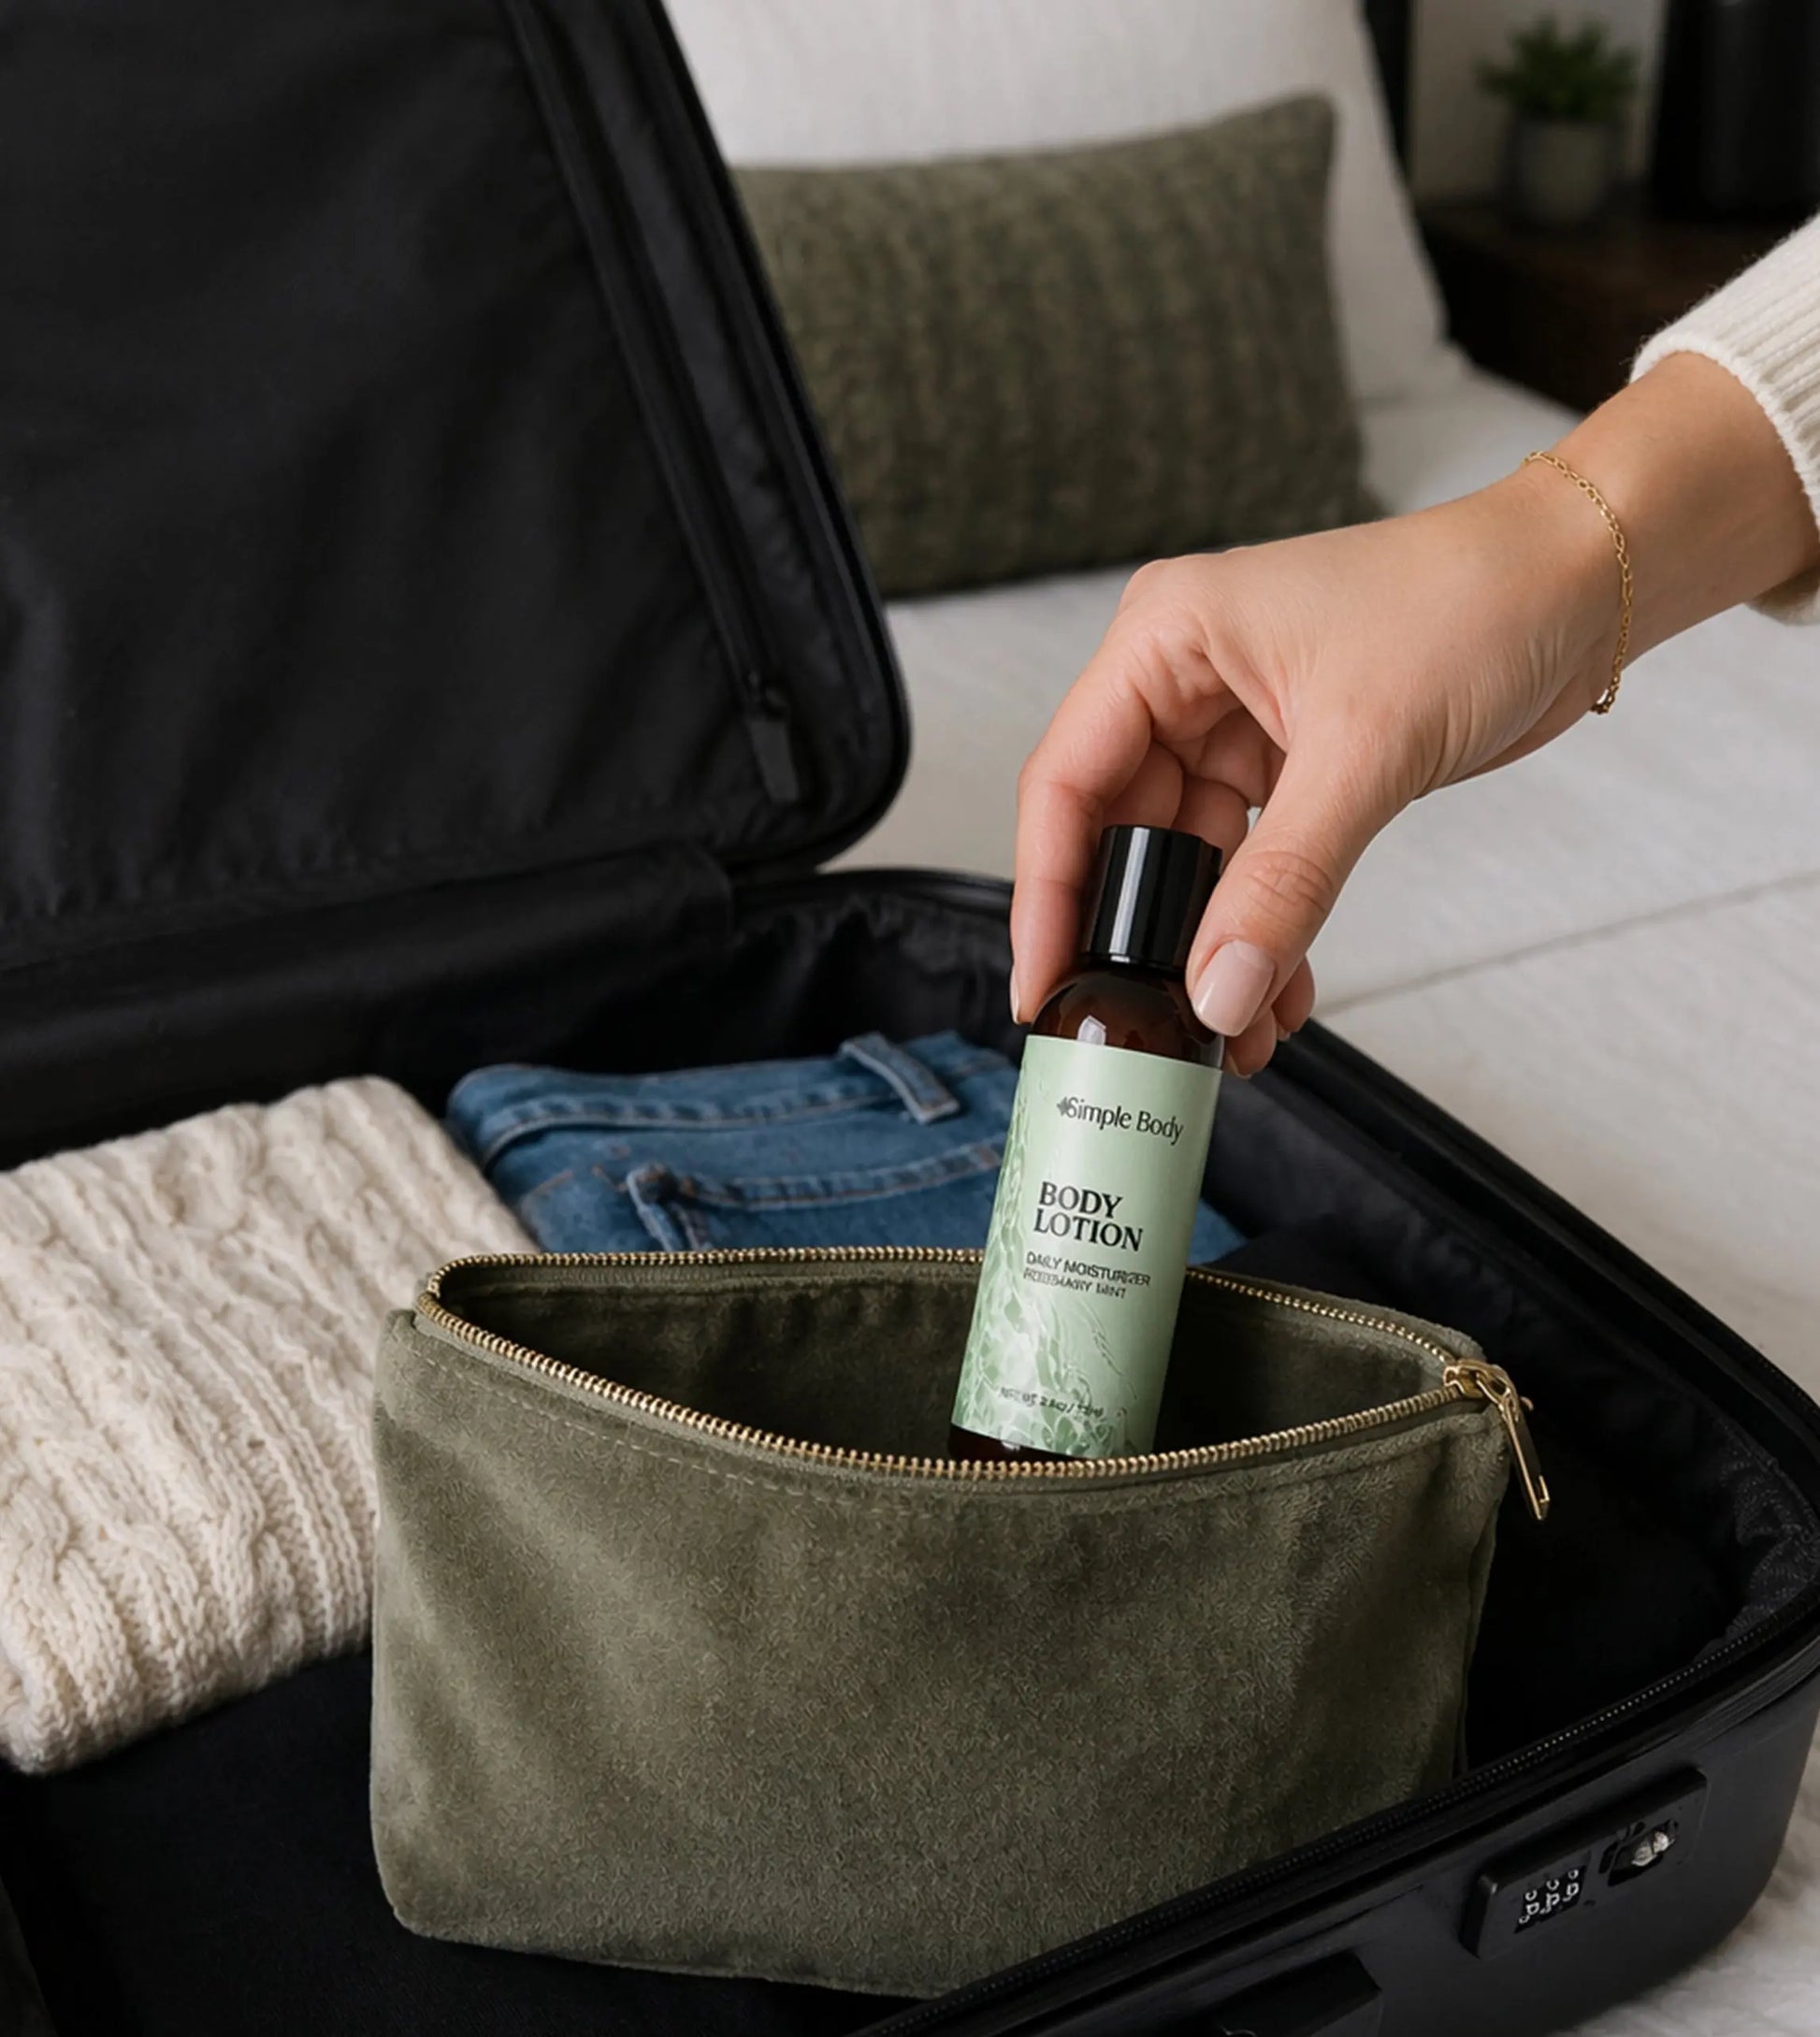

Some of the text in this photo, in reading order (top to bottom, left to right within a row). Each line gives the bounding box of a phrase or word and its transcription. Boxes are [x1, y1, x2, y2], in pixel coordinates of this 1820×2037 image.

[1066, 1096, 1184, 1146] Simple Body
[1039, 1181, 1123, 1219] BODY
[1033, 1207, 1144, 1251] LOTION
